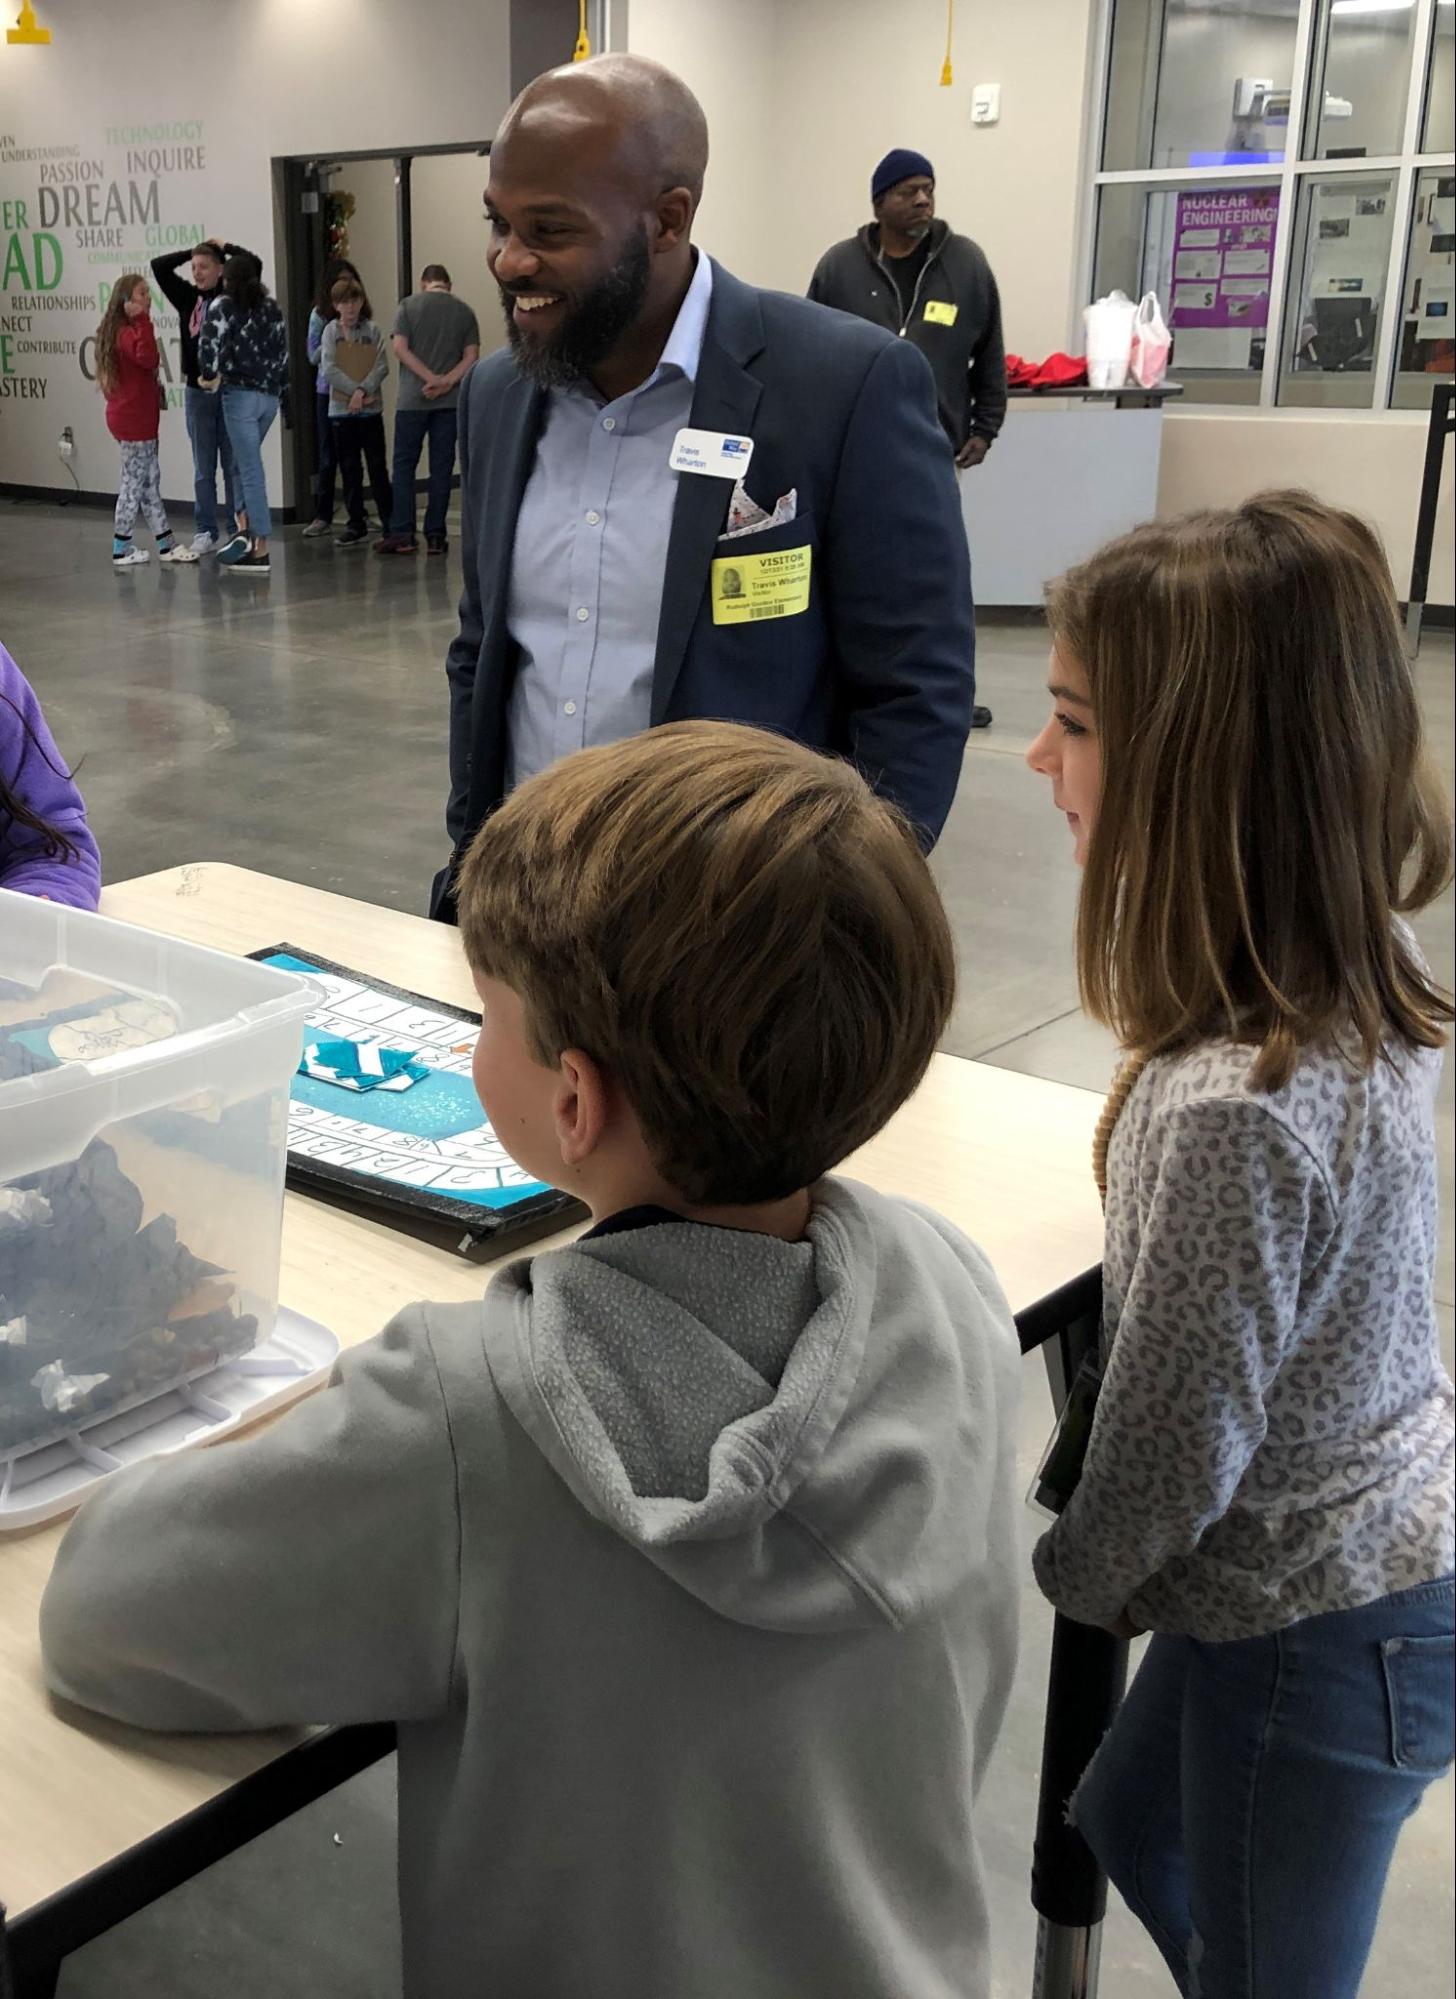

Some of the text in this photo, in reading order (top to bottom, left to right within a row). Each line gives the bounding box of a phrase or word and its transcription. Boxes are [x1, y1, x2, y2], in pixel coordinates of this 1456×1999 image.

[105, 121, 204, 146] TECHNOLOGY
[2, 145, 80, 163] UNDERSTANDING
[127, 147, 206, 177] INQUIRE
[40, 160, 104, 184] PASSION
[38, 180, 160, 229] DREAM
[1182, 194, 1248, 210] NUCLEAR
[75, 229, 123, 248] SHARE
[11, 295, 97, 311] RELATIONSHIPS
[0, 316, 32, 332] NECT
[17, 340, 76, 354] CONTRIBUTE
[759, 553, 803, 567] VISITOR
[752, 580, 776, 590] Travis
